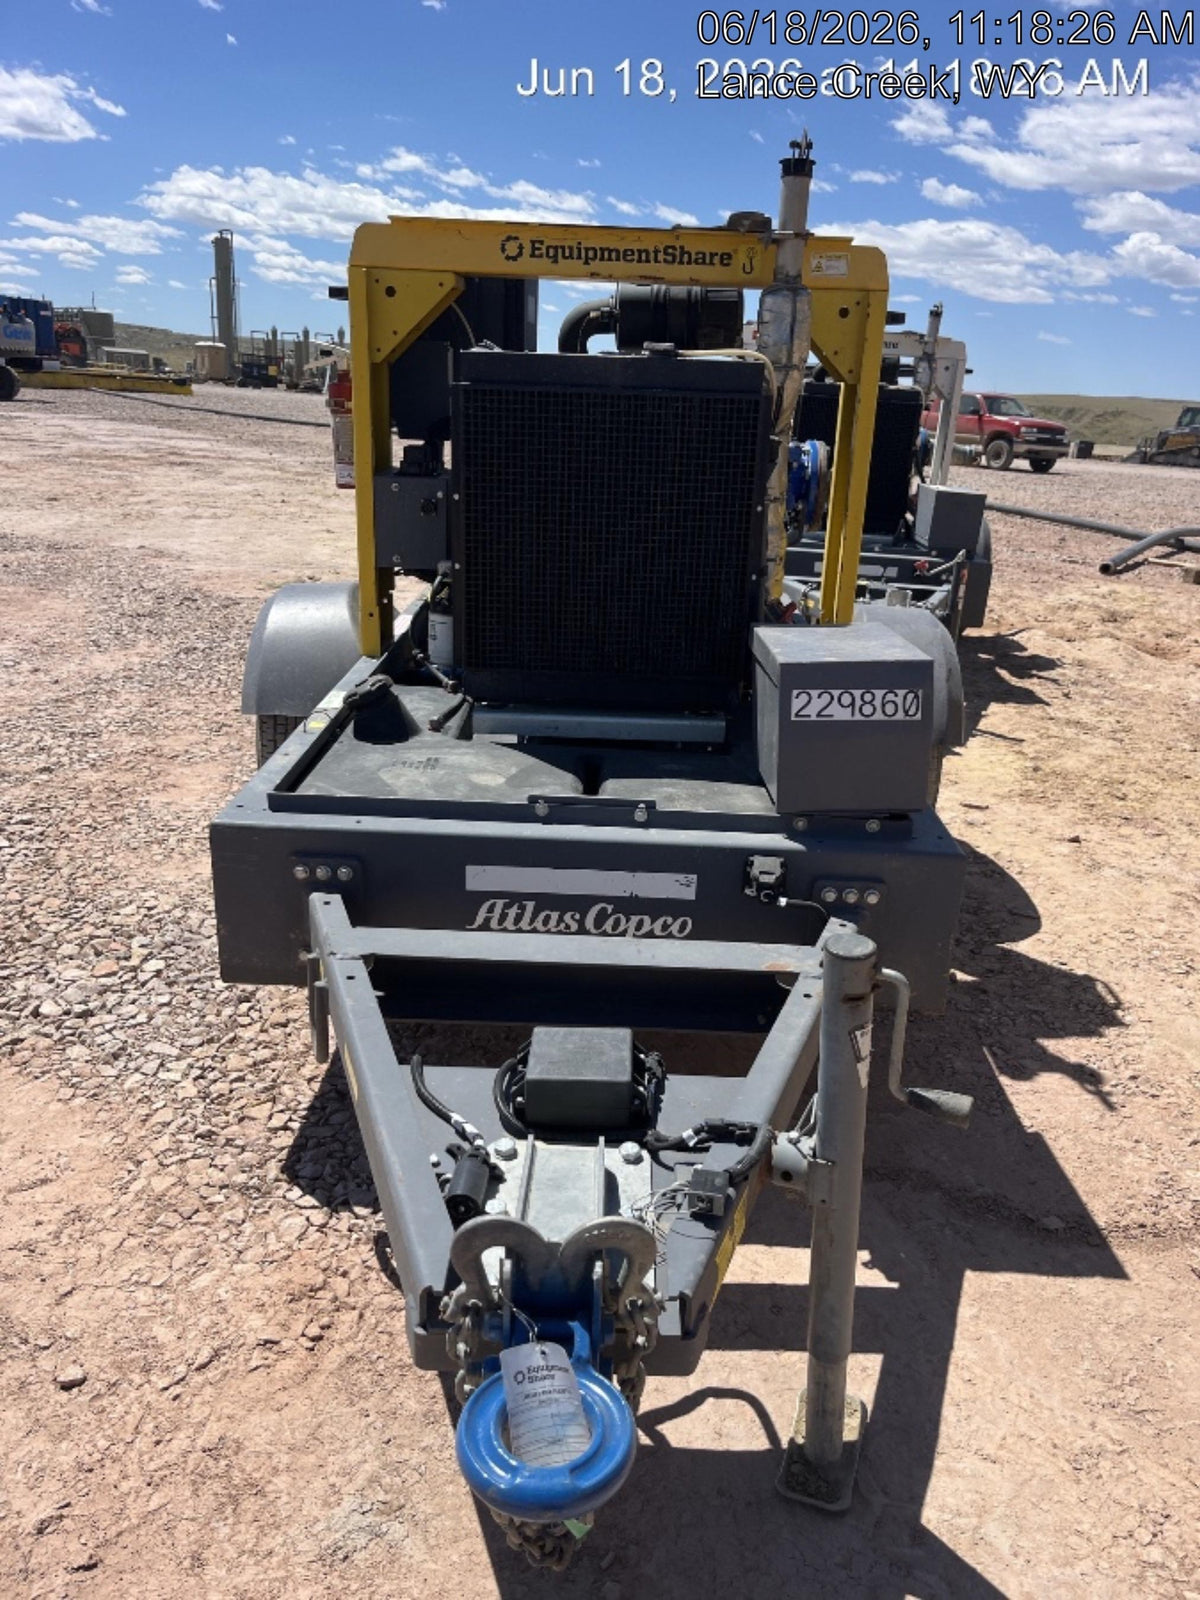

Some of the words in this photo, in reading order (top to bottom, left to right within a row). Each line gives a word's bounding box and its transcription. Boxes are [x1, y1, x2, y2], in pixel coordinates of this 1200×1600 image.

[529, 239, 733, 267] EquipmentShare
[794, 690, 921, 718] 229860
[466, 898, 580, 933] Atlas
[584, 902, 692, 938] Copco
